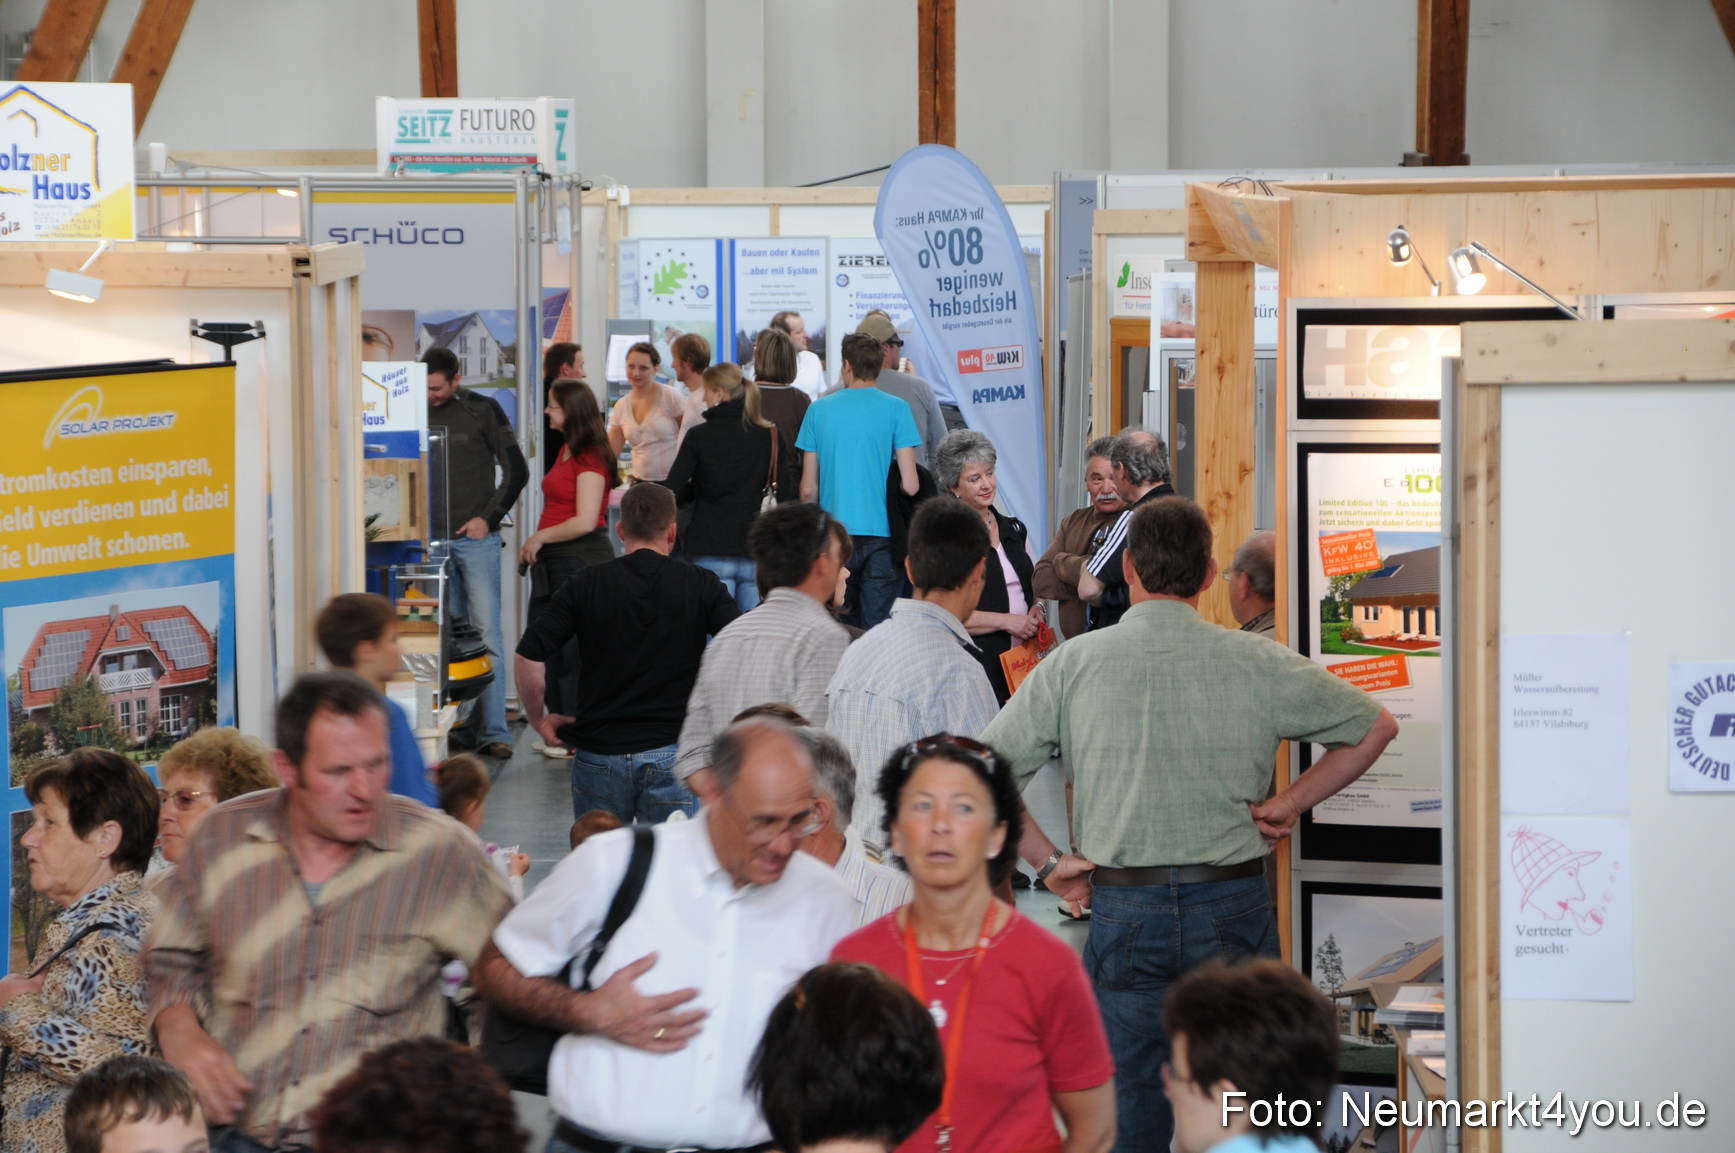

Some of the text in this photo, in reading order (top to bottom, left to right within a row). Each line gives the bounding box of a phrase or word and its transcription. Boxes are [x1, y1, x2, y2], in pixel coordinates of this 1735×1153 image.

[461, 109, 535, 131] FUTURO
[397, 116, 451, 137] SEITZ
[461, 135, 536, 145] HAUSTÜREN
[32, 174, 91, 200] Haus
[328, 221, 464, 244] SCHÜCO
[741, 248, 820, 257] Bauen oder Kaufen
[771, 266, 785, 275] mit
[787, 266, 818, 276] System
[395, 376, 407, 387] aus
[60, 414, 174, 436] SOLAR PROJEKT
[0, 458, 213, 495] tromkosten einsparen,
[0, 484, 229, 532] eld verdienen und dabei
[1347, 499, 1373, 507] Edition
[1376, 499, 1388, 507] 100
[1336, 508, 1392, 517] sensationellen
[0, 531, 190, 570] ie Umwelt schonen.
[1326, 551, 1374, 564] INKLUSIVE
[1344, 664, 1366, 673] HABEN
[1375, 679, 1391, 687] Preis
[1514, 673, 1543, 682] Müller
[1514, 685, 1600, 695] Wasseraufbereitung
[1562, 708, 1573, 716] 82
[1513, 719, 1589, 730] 84137 Vilsbiburg
[1674, 705, 1730, 781] DEUTSCHER
[1516, 924, 1573, 937] Vertreter
